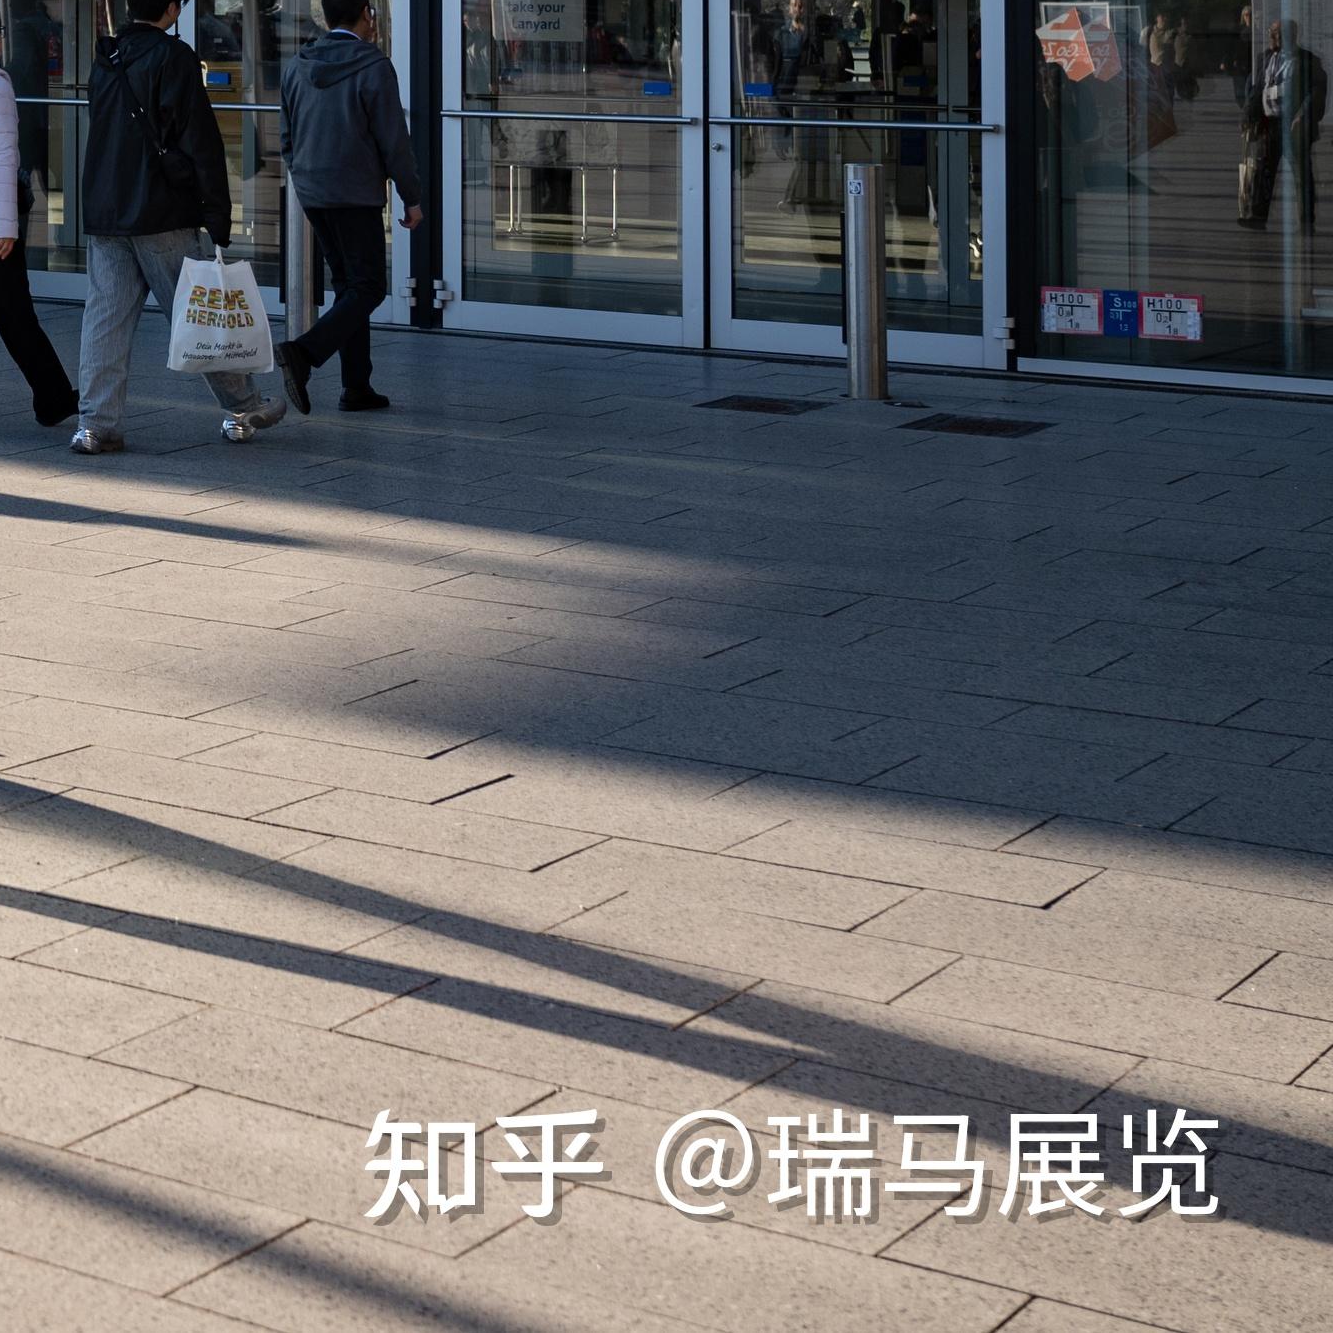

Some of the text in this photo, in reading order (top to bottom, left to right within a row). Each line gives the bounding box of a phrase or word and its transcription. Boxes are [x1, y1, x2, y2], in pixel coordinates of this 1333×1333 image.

[508, 1, 565, 16] take your
[1049, 293, 1084, 305] H100
[1147, 298, 1182, 310] H100
[186, 308, 255, 329] HERHOLD
